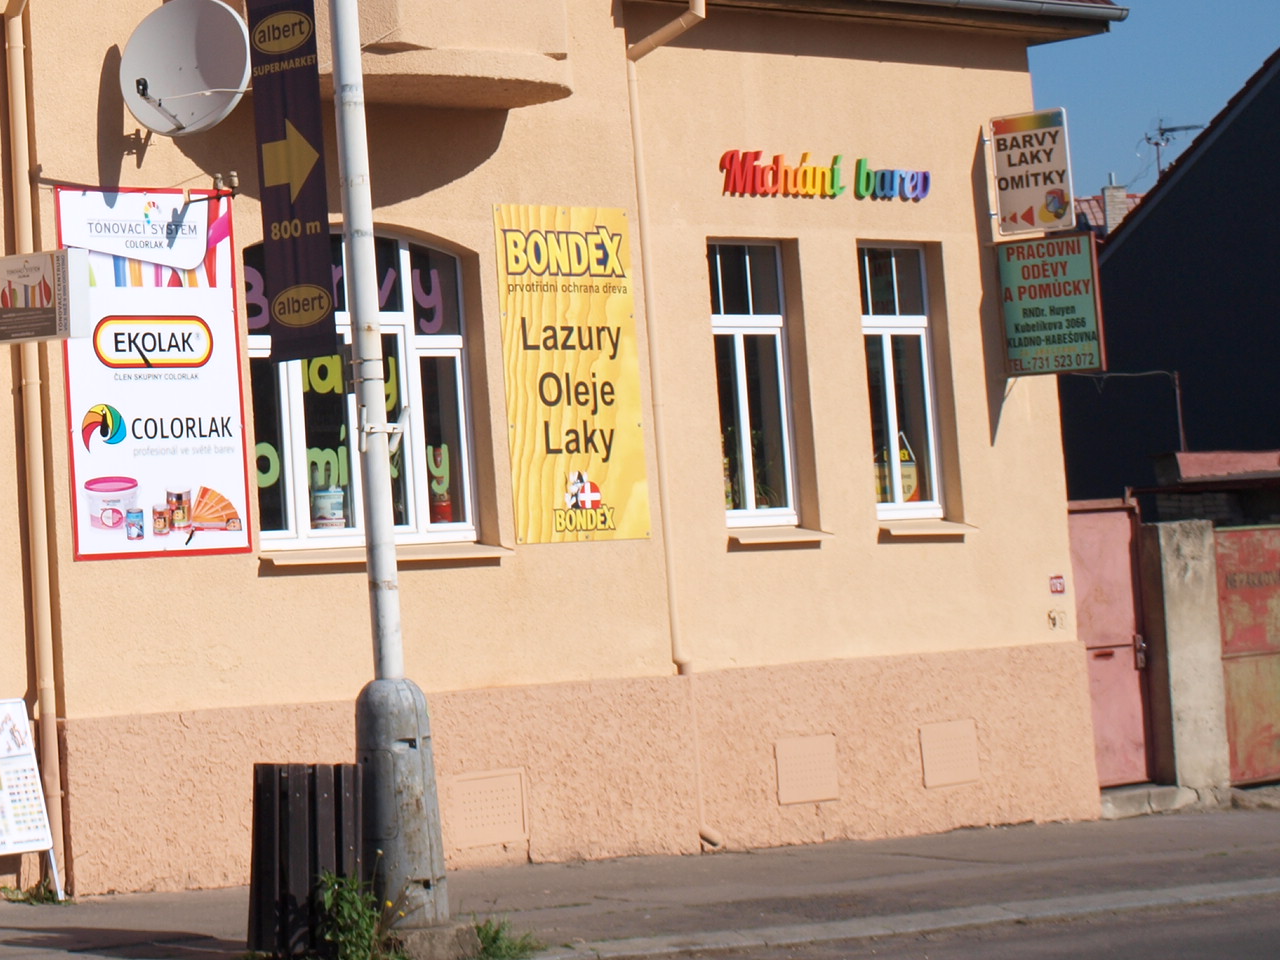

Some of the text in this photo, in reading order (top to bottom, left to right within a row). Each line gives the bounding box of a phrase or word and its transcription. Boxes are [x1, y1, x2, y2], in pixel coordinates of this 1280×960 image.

[257, 17, 305, 44] albert
[253, 53, 317, 77] SUPERMARKET
[996, 130, 1060, 152] BARVY
[1007, 148, 1054, 167] LAKY
[854, 157, 931, 201] barev
[998, 169, 1066, 191] OMÍTKY
[270, 219, 320, 240] 800 m
[125, 240, 164, 249] COLORLAK
[501, 226, 627, 278] BONDEX
[1021, 260, 1068, 281] ODĚVY
[561, 282, 600, 295] ochrana
[602, 282, 628, 295] dřeva
[1004, 278, 1092, 302] A POMŮCKY
[277, 292, 325, 317] albert
[113, 331, 195, 356] EKOLAK
[520, 316, 622, 360] Lazury
[1054, 355, 1073, 368] 523
[1075, 352, 1095, 367] 072
[113, 372, 199, 381] ČLEN SKUPINY COLORLAK
[538, 371, 616, 416] Oleje
[131, 416, 233, 440] COLORLAK
[543, 419, 615, 463] Laky
[553, 503, 616, 533] BONDEX
